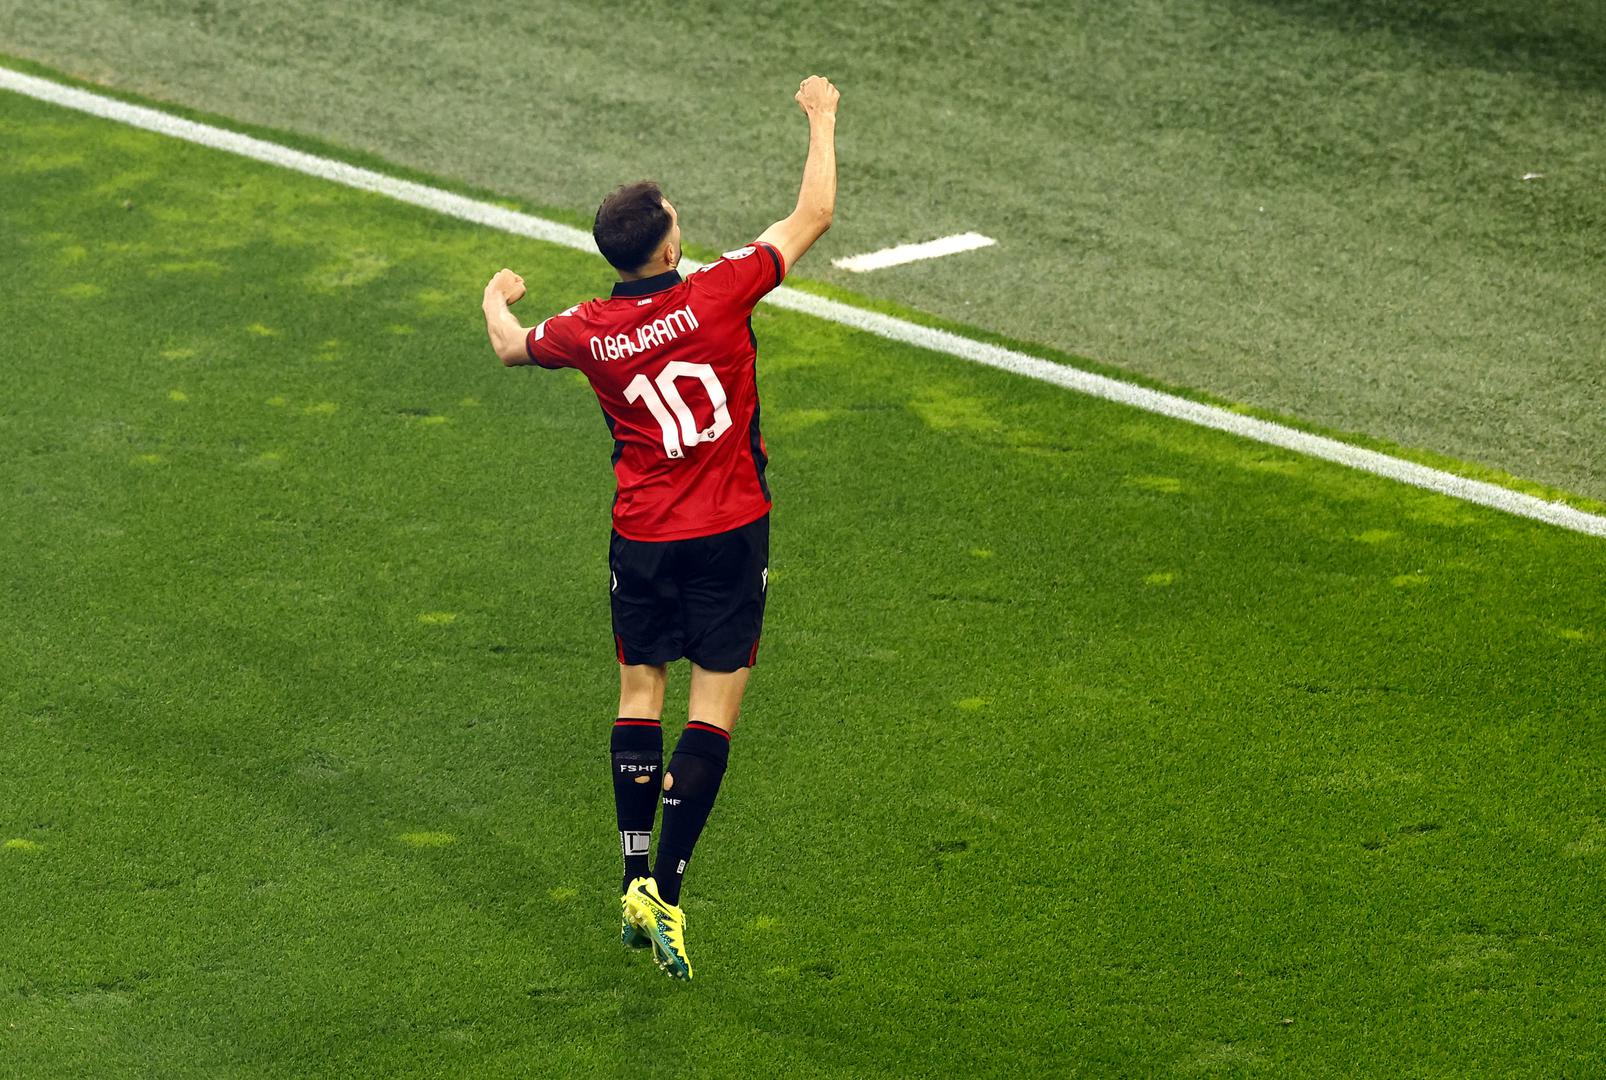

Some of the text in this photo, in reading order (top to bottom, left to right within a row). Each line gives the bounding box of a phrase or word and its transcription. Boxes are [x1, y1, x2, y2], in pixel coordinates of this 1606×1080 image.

[590, 305, 699, 361] N.BAJRAMI
[622, 360, 733, 459] 10
[620, 764, 658, 773] FSHF
